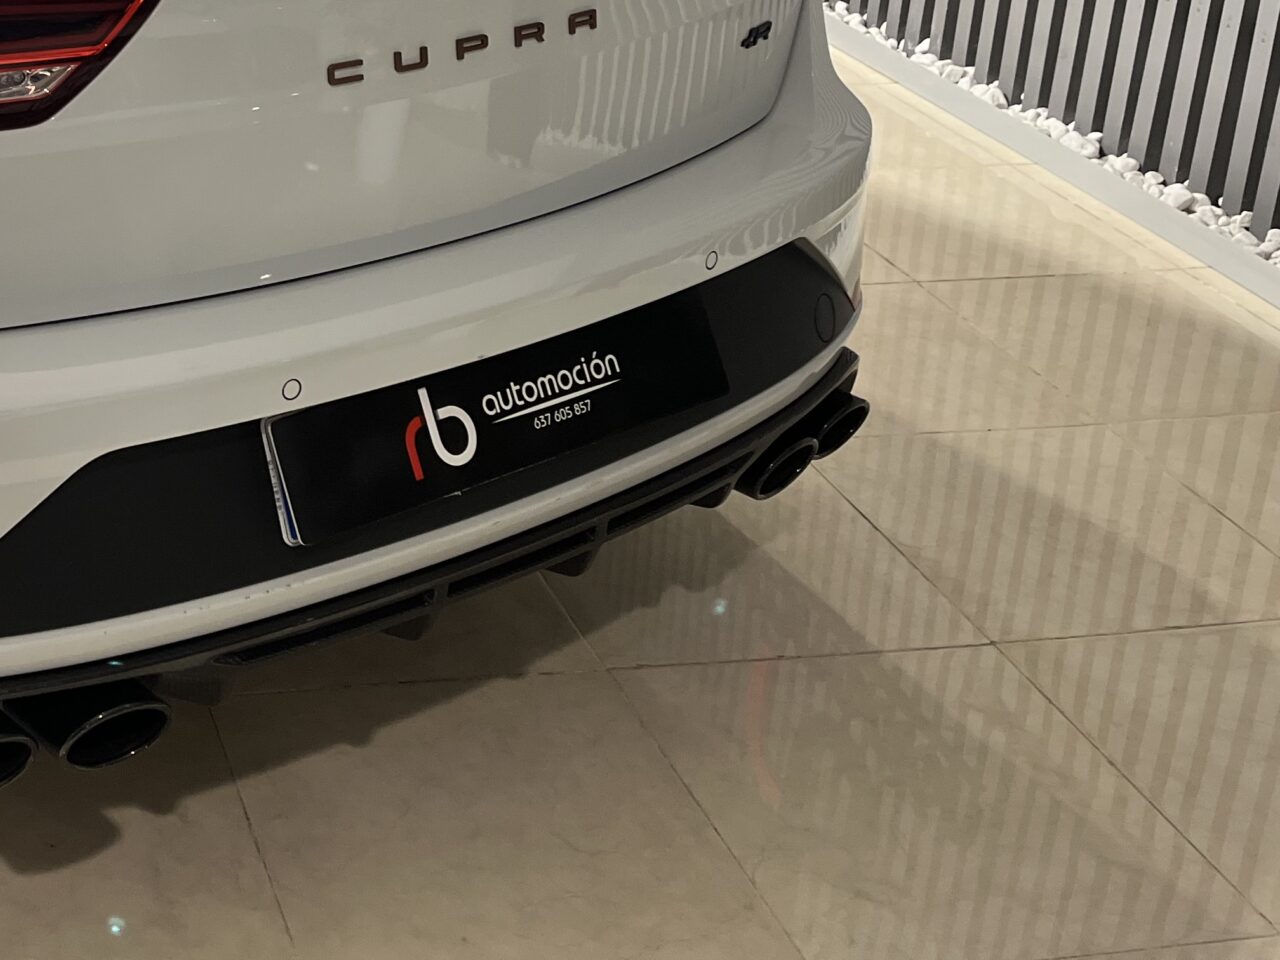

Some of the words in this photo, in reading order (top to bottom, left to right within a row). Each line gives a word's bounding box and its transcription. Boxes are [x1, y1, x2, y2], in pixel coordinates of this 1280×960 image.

[326, 8, 598, 87] CUPRA
[481, 350, 621, 415] automoción
[533, 412, 552, 430] 637
[553, 405, 574, 423] 605
[573, 398, 592, 416] 857
